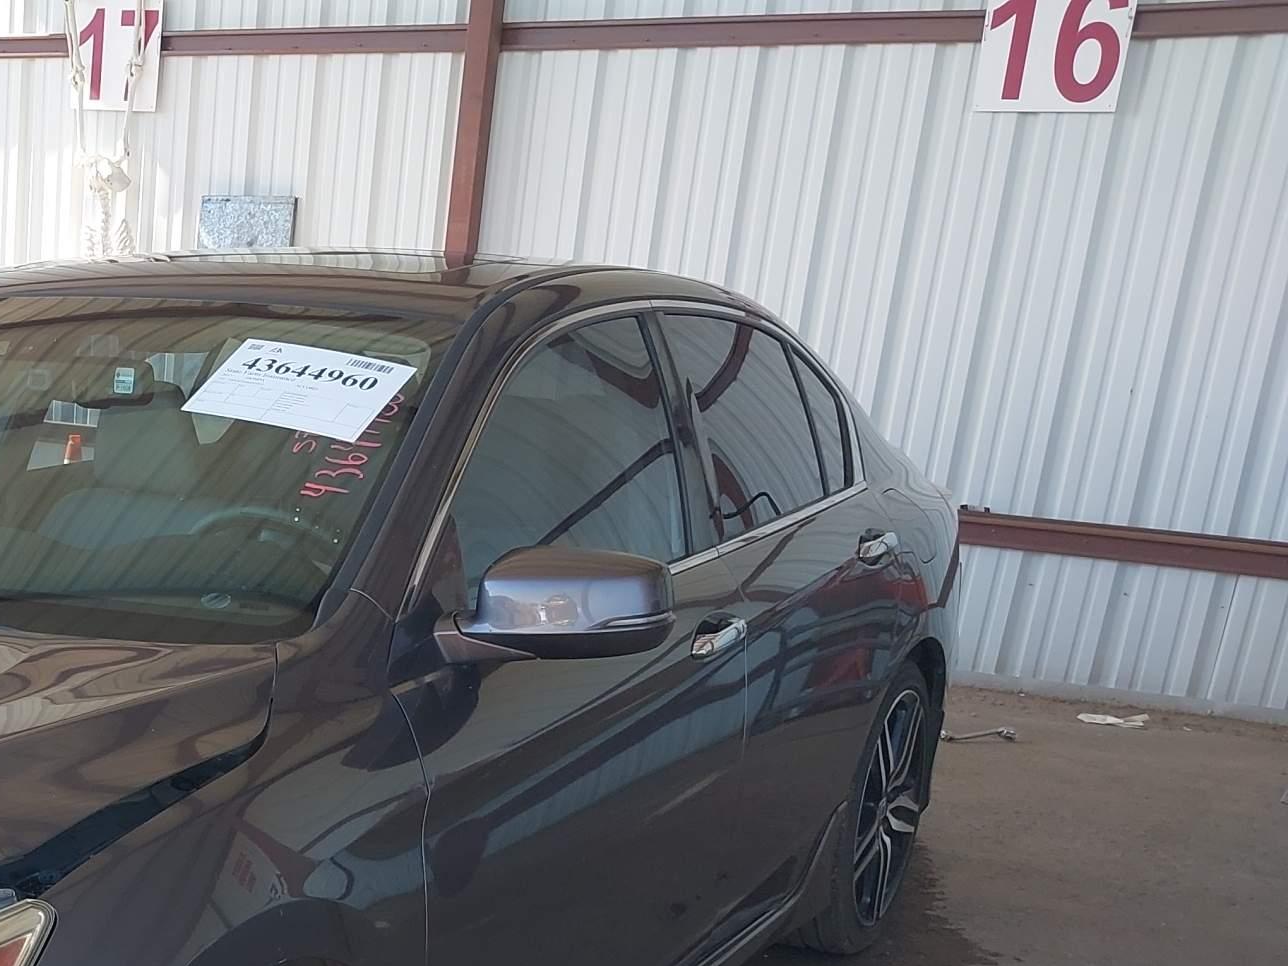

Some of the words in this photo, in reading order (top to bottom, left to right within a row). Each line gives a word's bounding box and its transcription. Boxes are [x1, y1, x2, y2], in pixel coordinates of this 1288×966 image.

[79, 8, 159, 101] 17
[990, 0, 1129, 103] 16
[241, 357, 379, 391] 43644960
